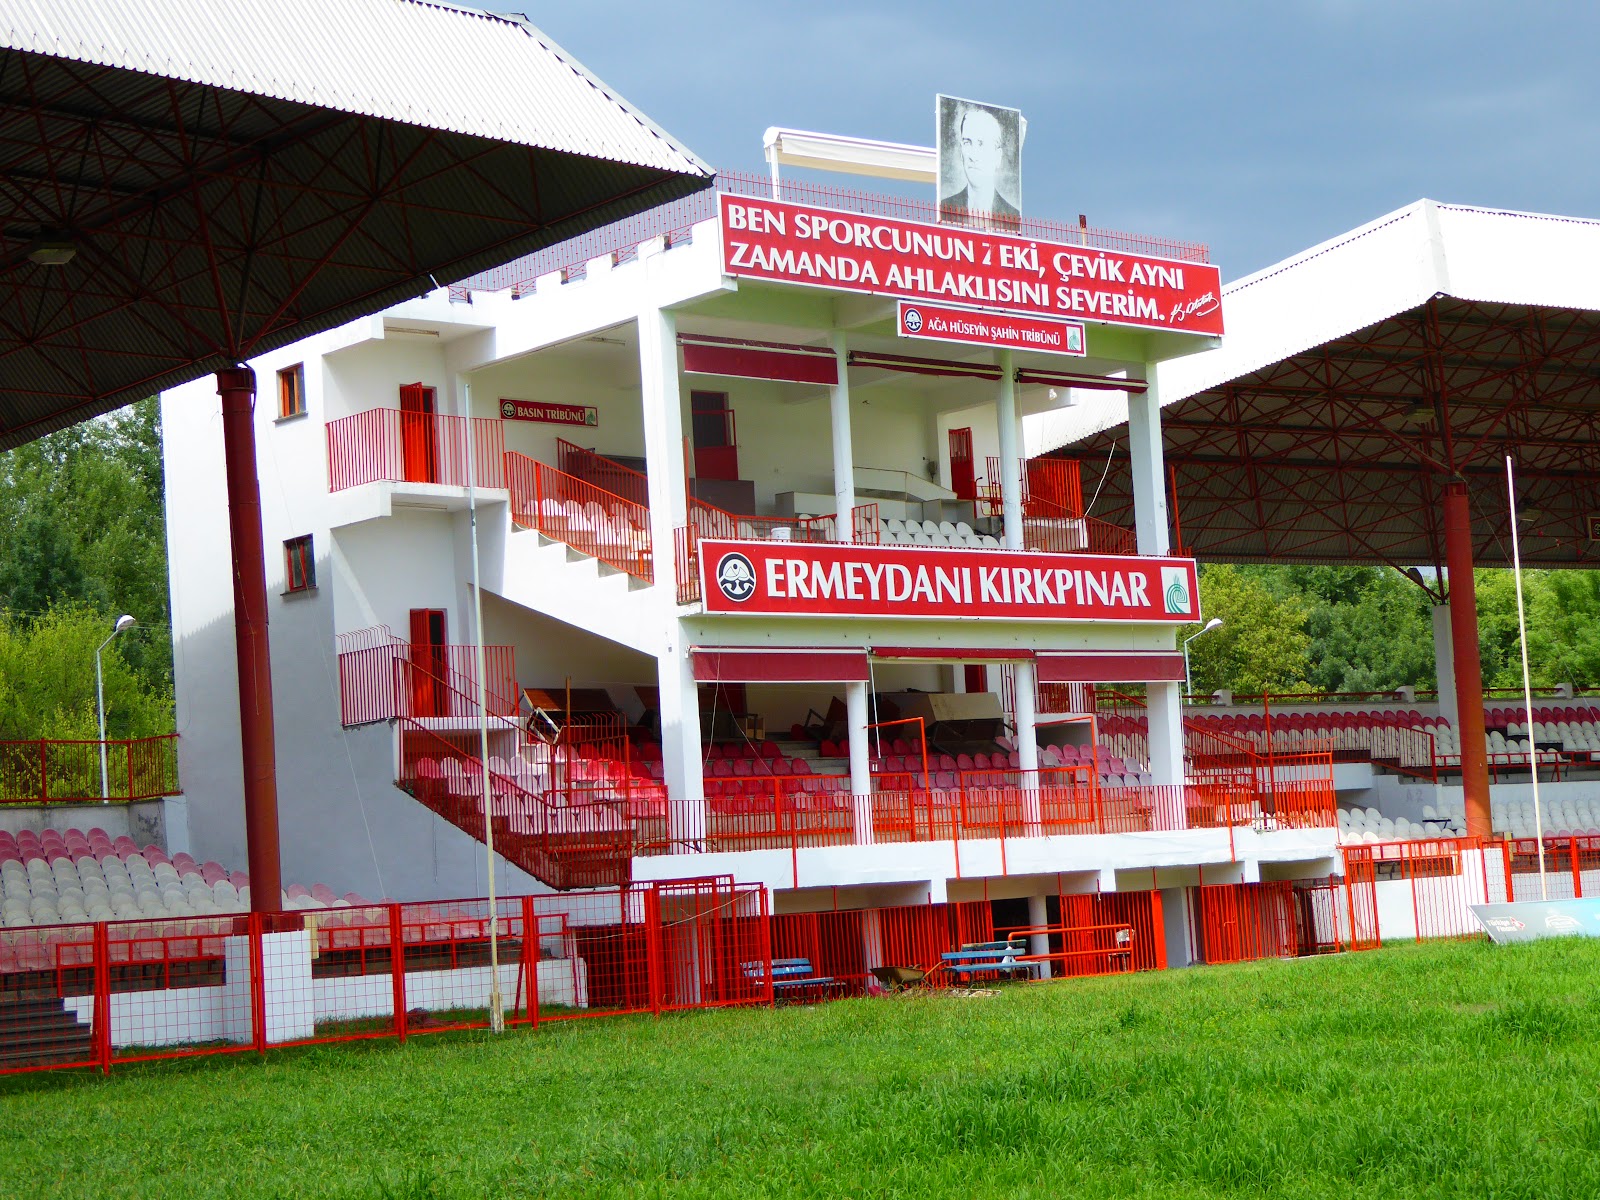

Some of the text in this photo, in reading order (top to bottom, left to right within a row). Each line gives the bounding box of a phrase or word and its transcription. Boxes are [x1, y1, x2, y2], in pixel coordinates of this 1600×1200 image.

[728, 204, 786, 235] BEN
[794, 213, 975, 263] SPORCUNUN
[1053, 252, 1128, 282] ÇEVİK
[1130, 265, 1185, 290] AYNI
[729, 241, 1166, 320] ZAMANDA AHLAKLISINI SEVERİM.
[927, 318, 1061, 345] AĞA HÜSEYİN ŞAHİN TRİBÜNÜ
[517, 406, 585, 422] BASIN TRİBÜNÜ
[765, 558, 1152, 607] ERMEYDANI KIRKPINAR
